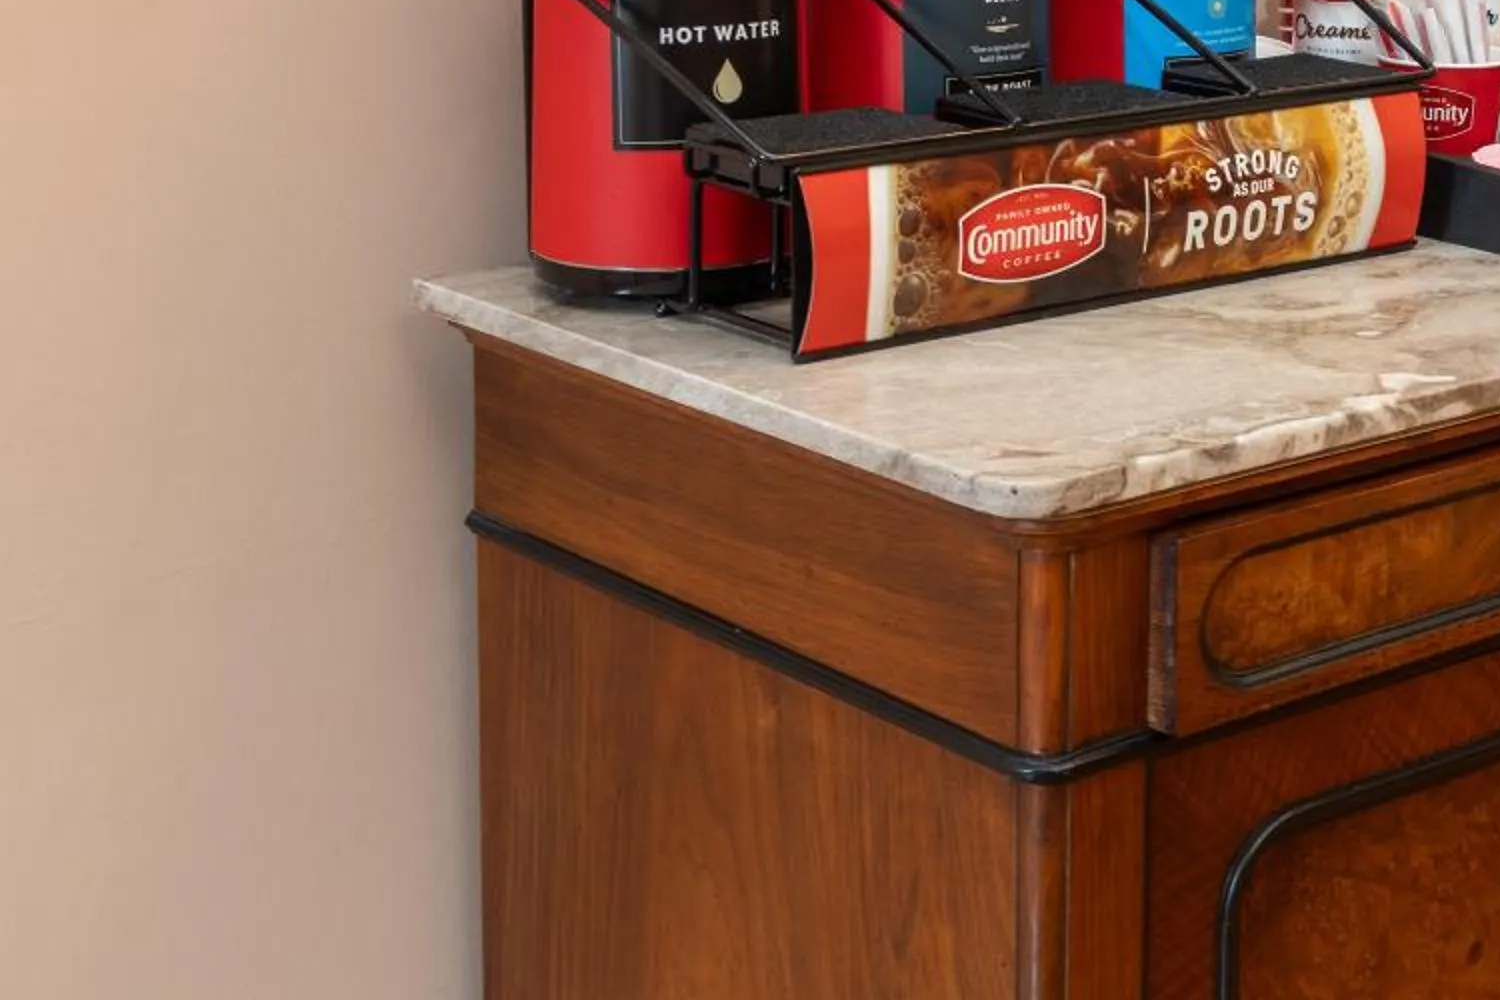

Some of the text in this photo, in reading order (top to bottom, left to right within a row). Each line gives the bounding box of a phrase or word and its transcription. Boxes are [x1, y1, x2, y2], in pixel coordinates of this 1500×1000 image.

[659, 20, 779, 45] HOT WATER
[1205, 149, 1300, 192] STRONG
[1233, 178, 1275, 197] AS OUR
[967, 210, 1099, 265] Community
[1183, 191, 1317, 252] ROOTS
[1002, 250, 1061, 269] COFFEE
